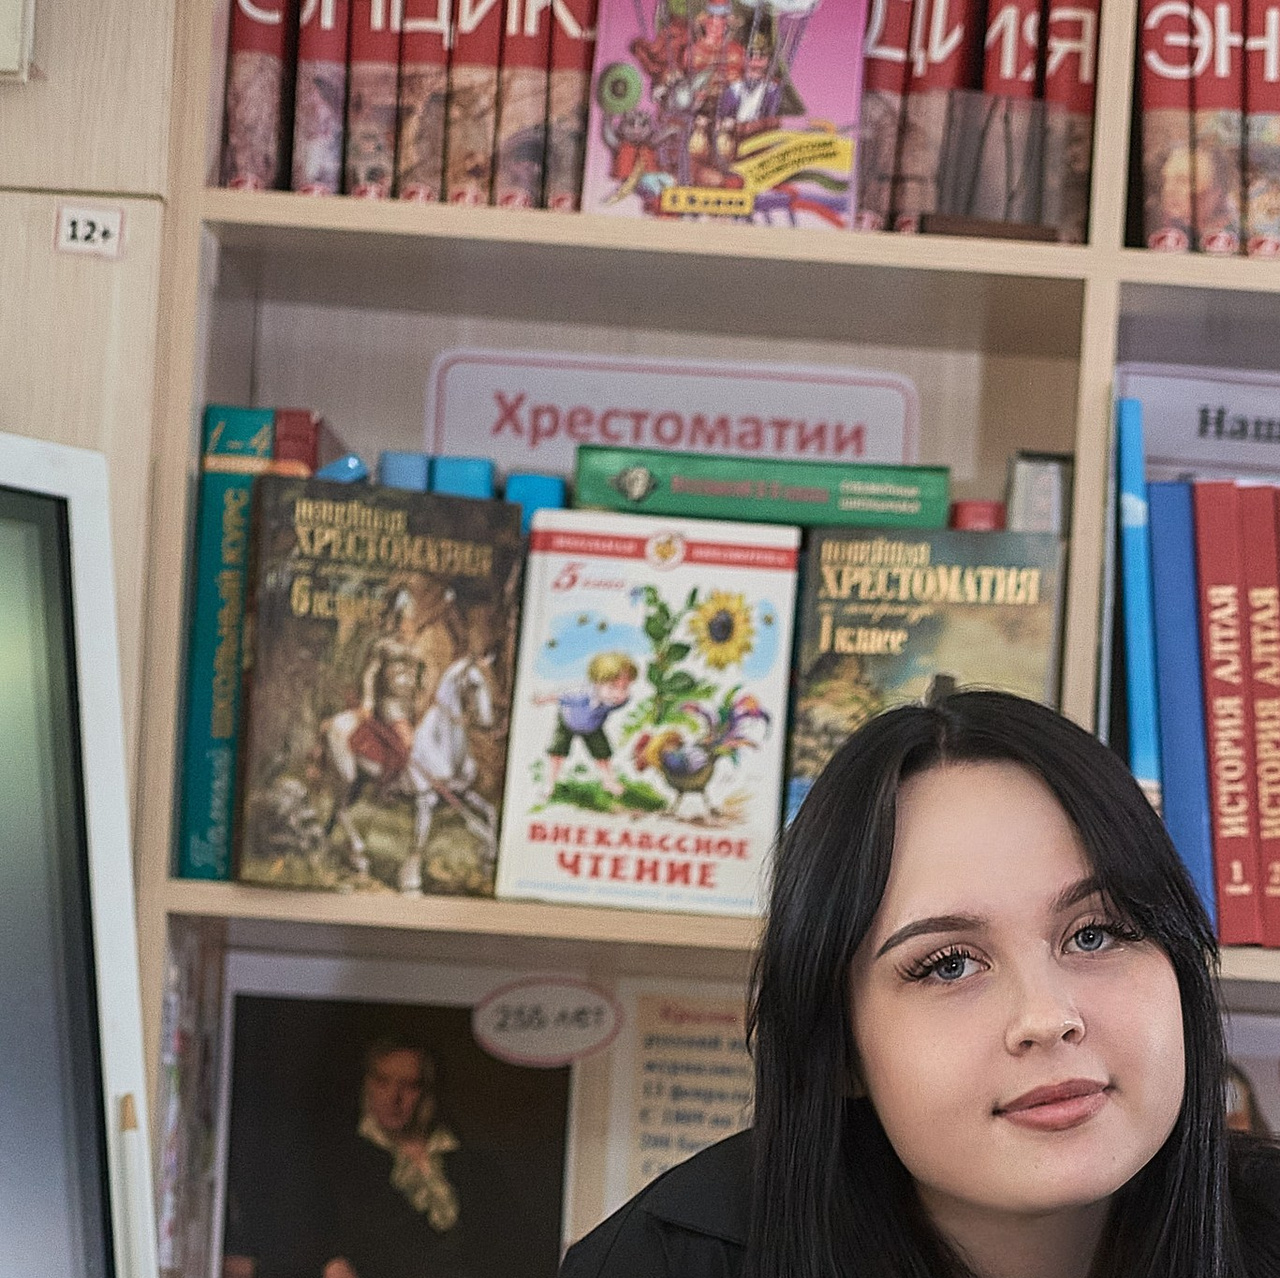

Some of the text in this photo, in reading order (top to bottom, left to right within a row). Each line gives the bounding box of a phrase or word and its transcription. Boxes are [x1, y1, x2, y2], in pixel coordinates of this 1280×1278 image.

[68, 219, 113, 242] 12+
[490, 391, 867, 457] Хрестоматии
[818, 564, 1042, 605] ХРЕСТОМАТИЯ
[1206, 584, 1250, 839] ИСТОРИЯ АЛТАЯ
[556, 850, 718, 890] ЧТЕНИЕ
